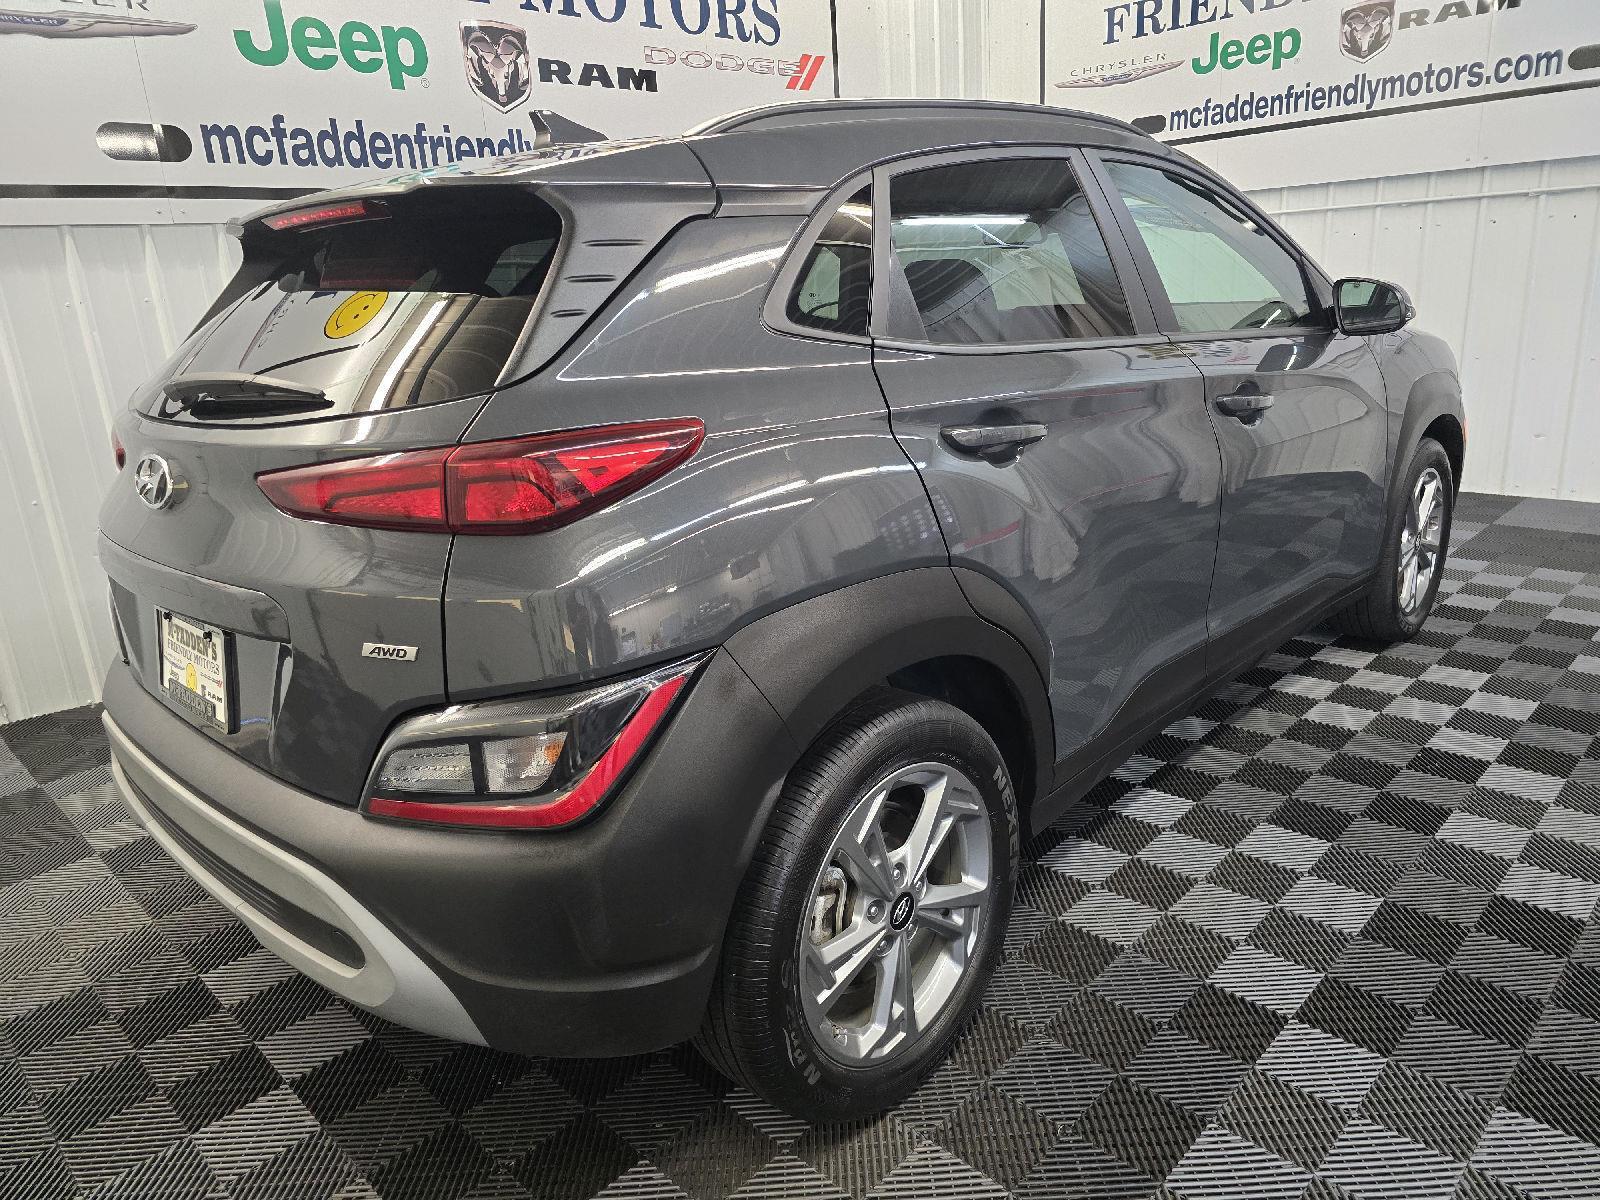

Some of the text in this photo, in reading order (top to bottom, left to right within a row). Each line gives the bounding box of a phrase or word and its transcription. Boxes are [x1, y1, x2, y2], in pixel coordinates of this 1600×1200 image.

[0, 14, 58, 25] HRYSLER
[1102, 0, 1300, 45] FRIE
[1398, 0, 1521, 30] RAM
[233, 0, 429, 90] Jeep
[643, 45, 801, 77] DODGE
[1191, 27, 1302, 75] Jeep
[538, 58, 659, 93] RAM
[1070, 53, 1167, 77] CHRYSLER
[1169, 48, 1564, 133] mcfaddenfriendlymotors.com
[200, 114, 533, 170] mcfaddenfriendl
[368, 646, 408, 659] AWD
[207, 691, 223, 704] RAM
